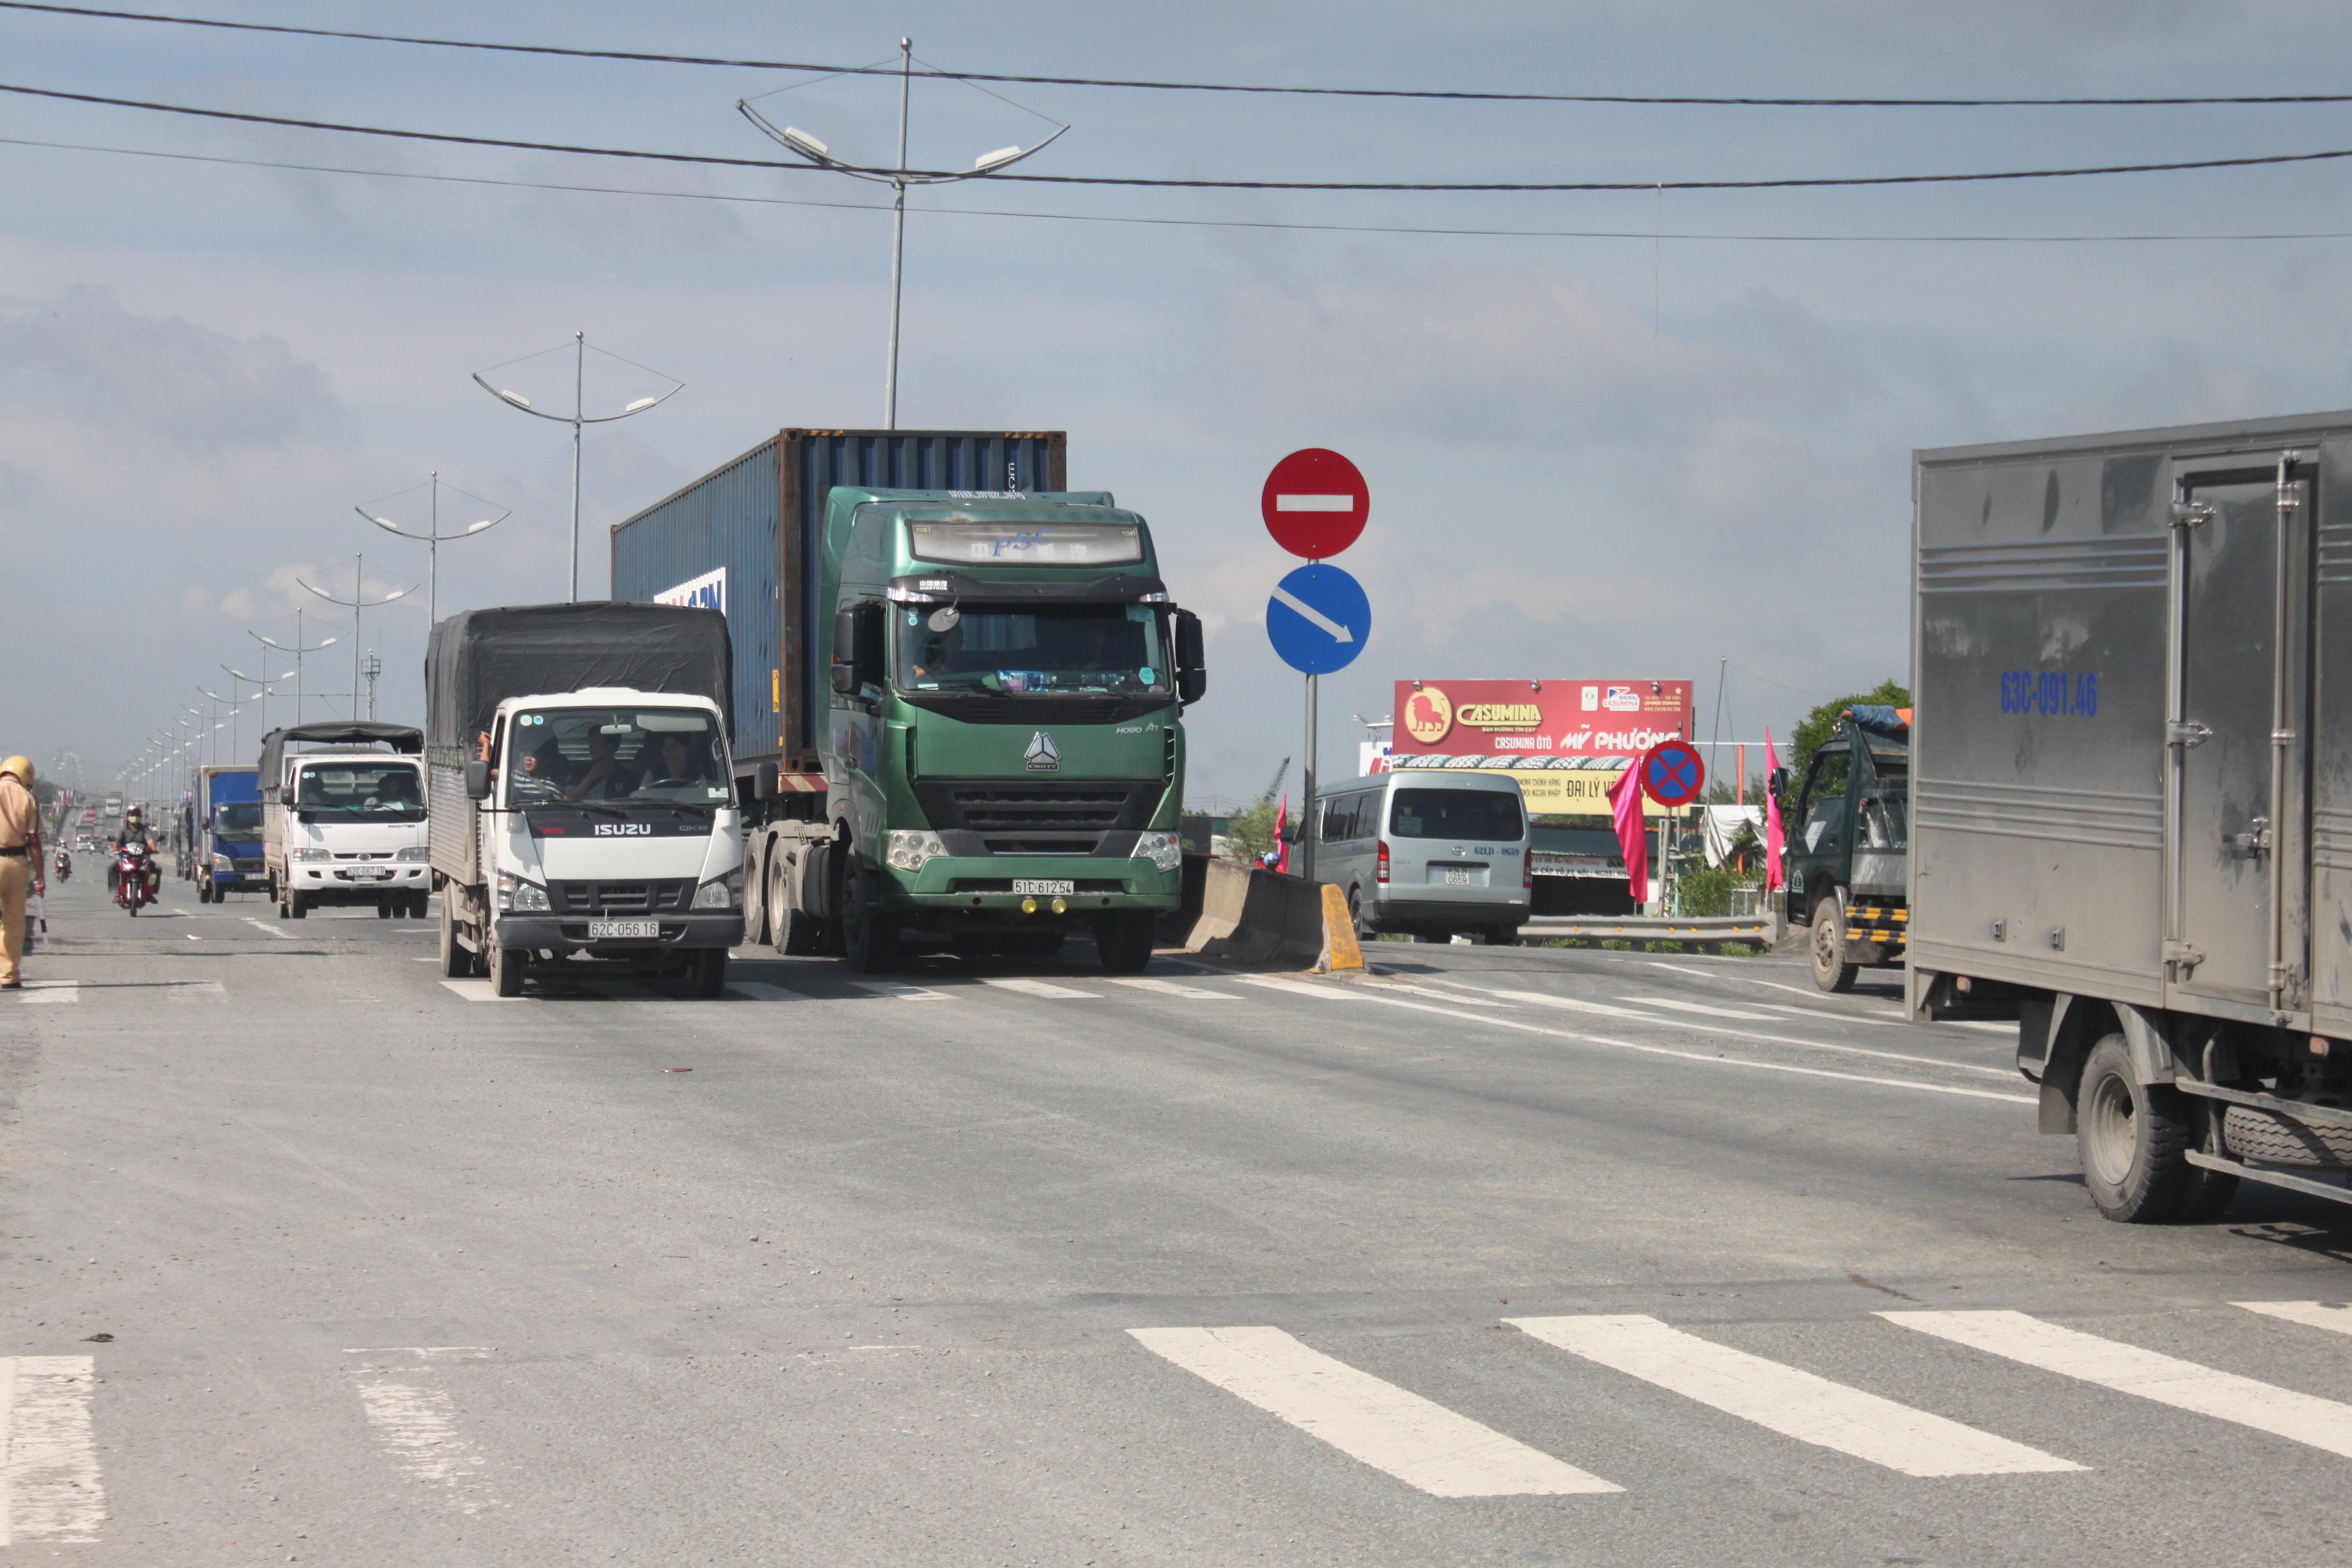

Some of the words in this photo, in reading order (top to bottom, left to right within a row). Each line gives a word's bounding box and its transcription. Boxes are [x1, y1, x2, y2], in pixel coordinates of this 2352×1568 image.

[992, 528, 1055, 557] PSC
[2002, 671, 2098, 717] 63C-091.46
[1457, 704, 1542, 726] CASUMINA
[1495, 736, 1534, 750] CASUMINA
[1537, 735, 1552, 750] ÔTÔ
[1560, 724, 1593, 750] MỸ
[1566, 780, 1585, 802] ĐẠI
[1589, 777, 1600, 797] LÝ
[595, 824, 651, 835] ISUZU
[1474, 846, 1494, 856] 62LD
[1502, 847, 1519, 856] 0659
[592, 923, 656, 936] 62C-056.16
